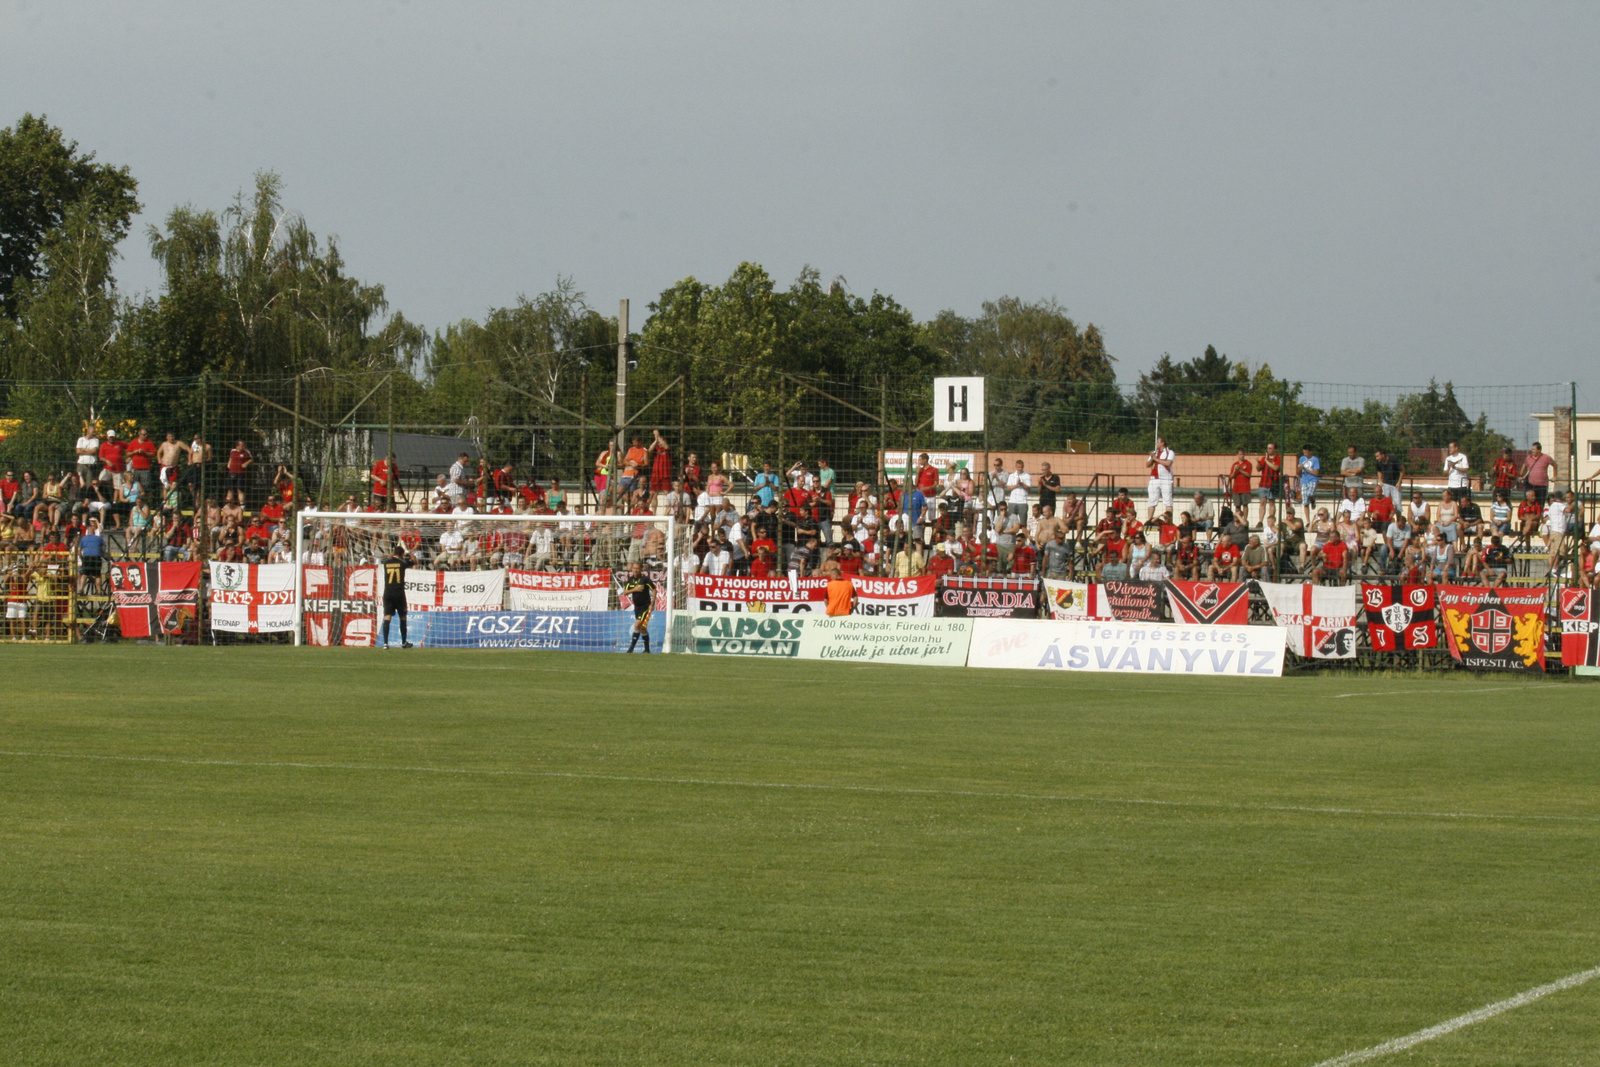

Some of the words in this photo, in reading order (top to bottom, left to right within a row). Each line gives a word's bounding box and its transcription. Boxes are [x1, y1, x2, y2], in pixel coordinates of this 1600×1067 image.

[948, 385, 968, 422] H
[386, 568, 401, 584] 71
[508, 572, 575, 588] KISPESTI
[686, 575, 713, 585] AND
[715, 578, 767, 589] THOUGH
[462, 584, 485, 593] 1909
[851, 577, 918, 595] PUSKÁS
[213, 589, 253, 605] URB
[263, 591, 294, 605] 1991
[705, 588, 746, 600] LASTS
[749, 589, 809, 600] FOREVER
[943, 589, 1035, 608] GUARDIA
[1439, 590, 1459, 604] Egy
[304, 599, 373, 612] KISPEST
[851, 602, 919, 617] KISPEST
[966, 607, 1014, 617] KISPEST
[466, 616, 526, 634] FGSZ
[531, 616, 579, 634] ZRT.
[812, 619, 836, 629] 7400
[840, 620, 892, 632] Kaposvár,
[896, 621, 930, 631] Füredi
[947, 623, 967, 632] 180.
[1319, 616, 1352, 627] ARMY
[834, 633, 942, 644] www.kaposvolan.hu
[1088, 625, 1247, 643] Természetes
[820, 645, 867, 659] Velünk
[868, 645, 885, 660] jó
[889, 644, 919, 656] úton
[921, 641, 953, 658] jár!
[987, 631, 1029, 657] ave
[1037, 638, 1276, 674] ÁSVÁNYVÍZ
[1464, 657, 1506, 669] ISPESTI
